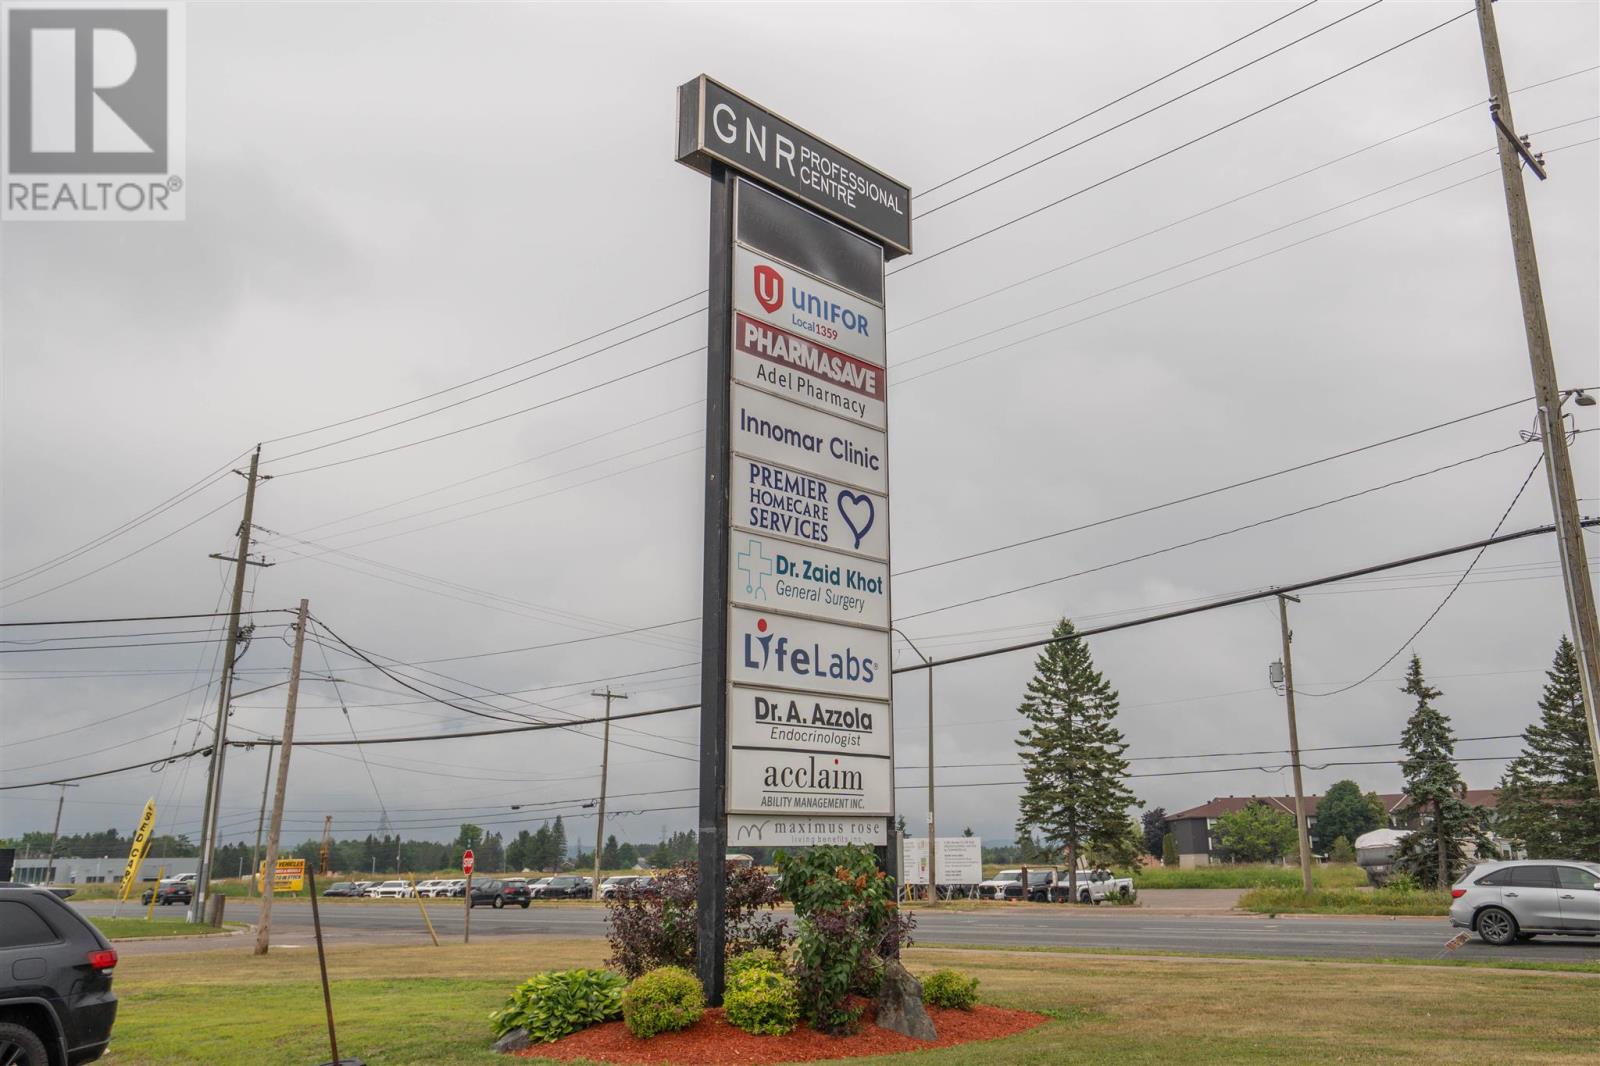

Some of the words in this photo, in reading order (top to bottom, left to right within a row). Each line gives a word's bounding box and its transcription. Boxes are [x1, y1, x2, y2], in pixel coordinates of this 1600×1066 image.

[800, 166, 856, 209] CENTRE
[801, 145, 903, 215] PROFESSIONAL
[744, 323, 877, 395] PHARMASAVE
[757, 364, 793, 390] Adel
[797, 376, 866, 418] Pharmacy
[740, 408, 823, 454] Innomar
[830, 437, 880, 471] Clinic
[749, 463, 829, 504] PREMIER
[750, 487, 829, 522] HOMECARE
[750, 507, 829, 542] SERVICES
[776, 579, 821, 601] General
[825, 588, 865, 613] Surgery
[847, 569, 882, 595] Khot
[755, 696, 782, 721] Dr.
[786, 700, 807, 724] A.
[811, 703, 873, 731] Azzola
[770, 726, 861, 747] Endocrinologist
[764, 756, 864, 790] acclaim
[761, 796, 792, 807] ABILITY
[793, 796, 849, 809] MANAGEMENT
[850, 799, 865, 809] INC.
[775, 818, 844, 834] maximus
[851, 822, 880, 834] rose
[791, 834, 815, 844] living
[817, 835, 848, 844] benefits
